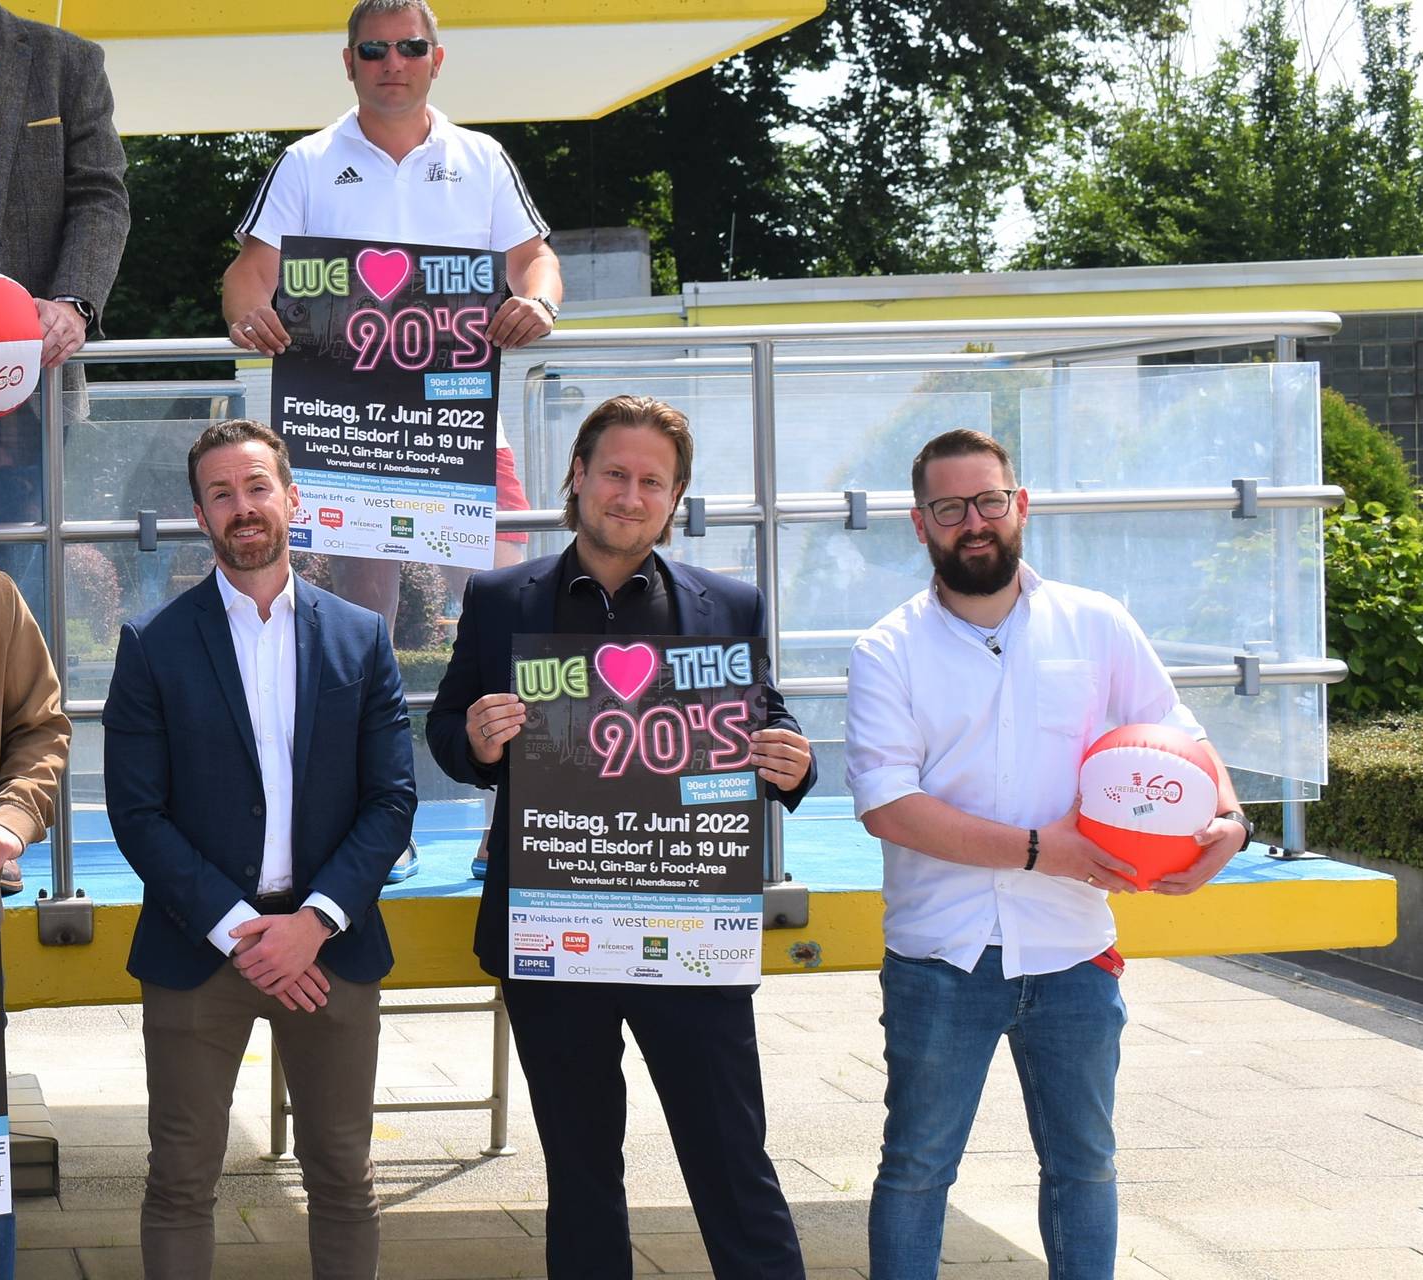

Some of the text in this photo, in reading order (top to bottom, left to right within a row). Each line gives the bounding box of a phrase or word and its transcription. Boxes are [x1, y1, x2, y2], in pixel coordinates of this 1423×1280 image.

[334, 176, 363, 185] adidas
[283, 255, 494, 297] WE THE
[346, 307, 493, 371] 90'S
[431, 377, 449, 387] 90er
[459, 376, 487, 386] 2000er
[433, 386, 483, 396] Trash Music
[391, 405, 432, 425] Juni
[436, 407, 484, 429] 2022
[282, 420, 484, 451] Freibad Elsdorf ab 19 Uhr
[351, 445, 394, 459] Gin-Bar
[406, 450, 464, 465] Food-Area
[325, 458, 440, 475] Vorverkauf 5€ Abendkasse 7€
[329, 493, 343, 502] Erft
[363, 497, 445, 513] westenergie
[453, 503, 493, 519] RWE
[440, 530, 490, 546] ELSDORF
[516, 642, 753, 702] WE THE
[589, 701, 753, 778] 90'S
[687, 780, 707, 791] 90er
[719, 778, 750, 788] 2000er
[1115, 786, 1145, 794] FREIBAD
[1145, 774, 1183, 804] 60
[692, 788, 747, 800] Trash Music
[643, 812, 690, 832] Juni
[695, 813, 749, 834] 2022
[522, 836, 750, 857] Freibad Elsdorf ab 19 Uhr
[599, 860, 647, 872] Gin-Bar
[661, 861, 727, 874] Food-Area
[570, 876, 699, 887] Vorverkauf 5€ Abendkasse 7€
[528, 914, 572, 923] Volksbank
[574, 916, 589, 924] Erft
[612, 916, 705, 932] westenergie
[714, 917, 758, 930] RWE
[565, 935, 587, 943] REWE
[698, 948, 755, 960] ELSDORF
[518, 958, 550, 968] ZIPPEL
